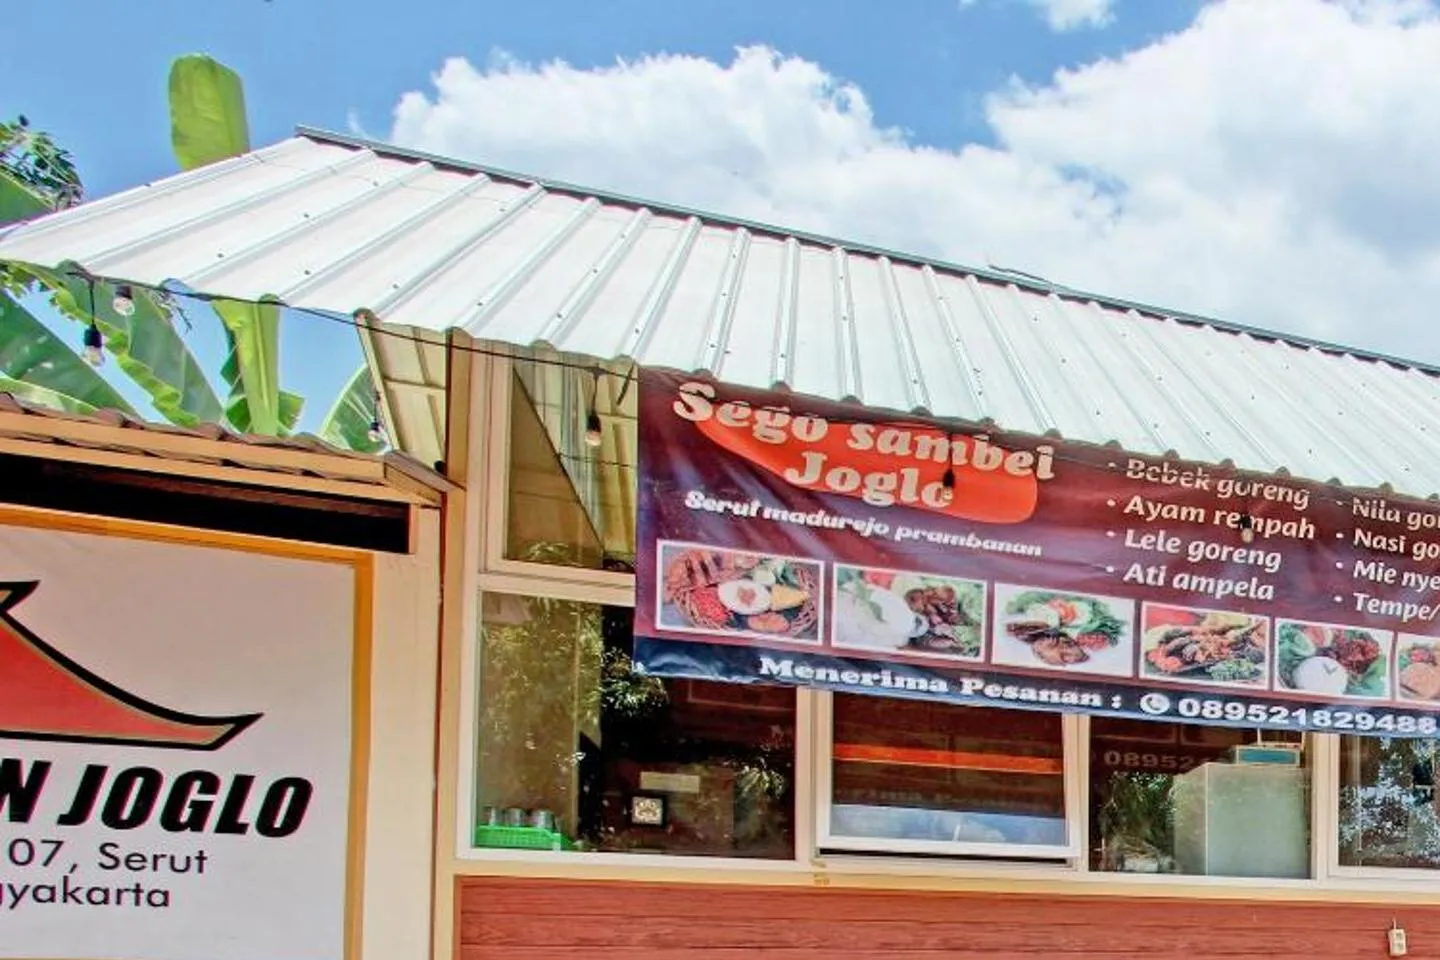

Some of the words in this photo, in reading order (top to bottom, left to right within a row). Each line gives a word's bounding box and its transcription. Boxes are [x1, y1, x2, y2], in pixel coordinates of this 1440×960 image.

[673, 382, 828, 443] Sego
[1126, 459, 1210, 490] Bebek
[1217, 479, 1310, 510] goreng
[685, 490, 761, 517] Serut
[763, 507, 889, 536] madurejo
[894, 526, 1041, 556] prambanan
[1124, 496, 1204, 523] Ayam
[1352, 497, 1400, 523] Nila
[1125, 529, 1180, 553] Lele
[1187, 540, 1281, 573] goreng
[1353, 528, 1406, 553] Nasi
[1123, 563, 1166, 586] Ati
[1172, 572, 1275, 600] ampela
[1353, 560, 1397, 584] Mie
[759, 658, 948, 693] Menerima
[960, 676, 1101, 707] Pesanan
[1178, 698, 1437, 734] 089521829488
[57, 764, 314, 838] JOGLO
[9, 838, 77, 873] 07,
[98, 842, 208, 874] Serut
[0, 875, 170, 909] yakarta
